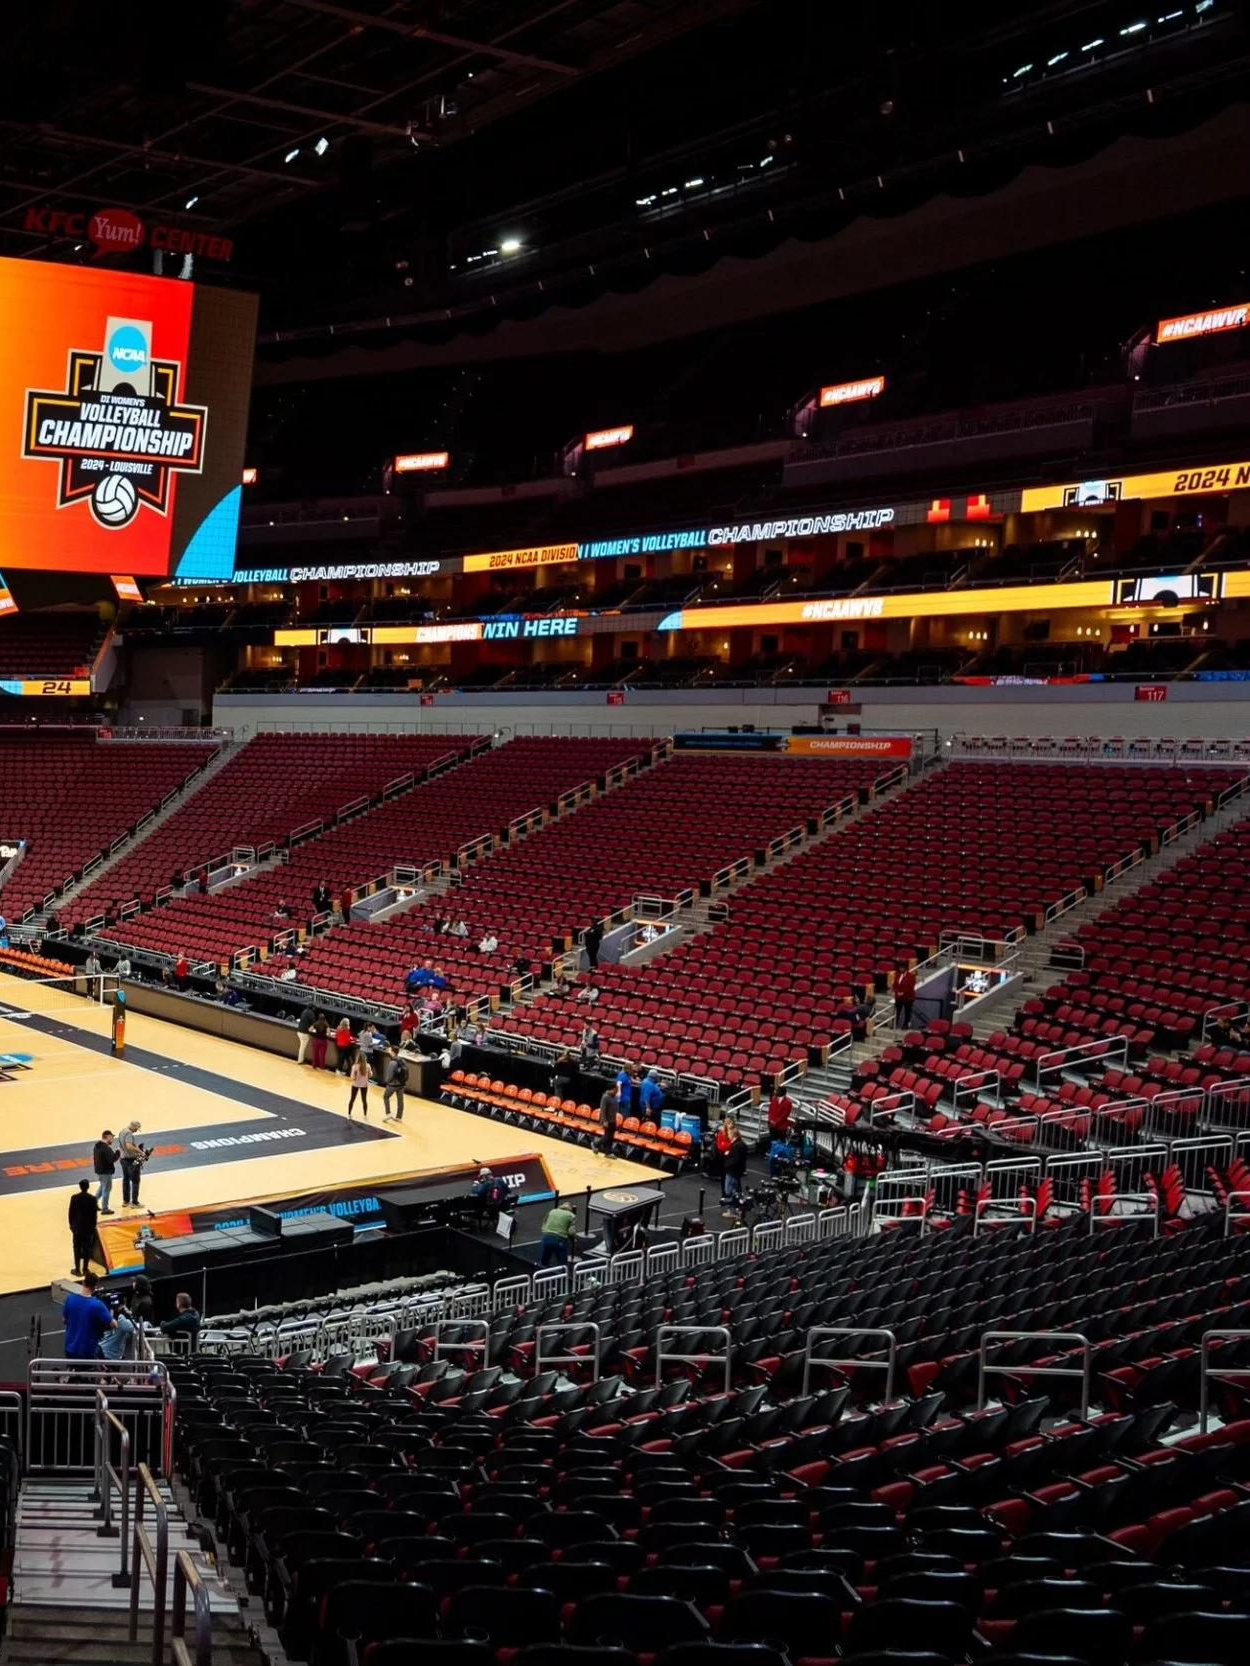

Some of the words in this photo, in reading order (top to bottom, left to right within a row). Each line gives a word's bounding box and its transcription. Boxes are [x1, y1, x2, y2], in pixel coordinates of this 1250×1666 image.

[25, 206, 85, 235] KFC
[94, 216, 142, 244] Yum!
[151, 226, 234, 260] CENTER
[112, 347, 146, 362] NCAA
[111, 395, 146, 408] WOMEN'S
[80, 402, 161, 428] VOLLEYBALL
[38, 419, 194, 457] CHAMPIONSHIP
[80, 458, 104, 470] 2024
[110, 460, 154, 475] LOUISVILLE
[1174, 468, 1230, 492] 2024
[489, 555, 513, 568] 2024
[515, 551, 539, 565] NCAA
[590, 538, 639, 557] WOMEN'S
[642, 530, 706, 552] VOLLEYBALL
[707, 508, 894, 546] CHAMPIONSHIP
[289, 560, 440, 583] CHAMPIONSHIP
[523, 617, 578, 637] HERE
[42, 681, 72, 694] 24
[1148, 690, 1164, 701] 117
[809, 740, 891, 750] CHAMPIONSHIP
[191, 1128, 307, 1151] CHAMPIONS
[329, 1196, 381, 1217] VOLLEYBA
